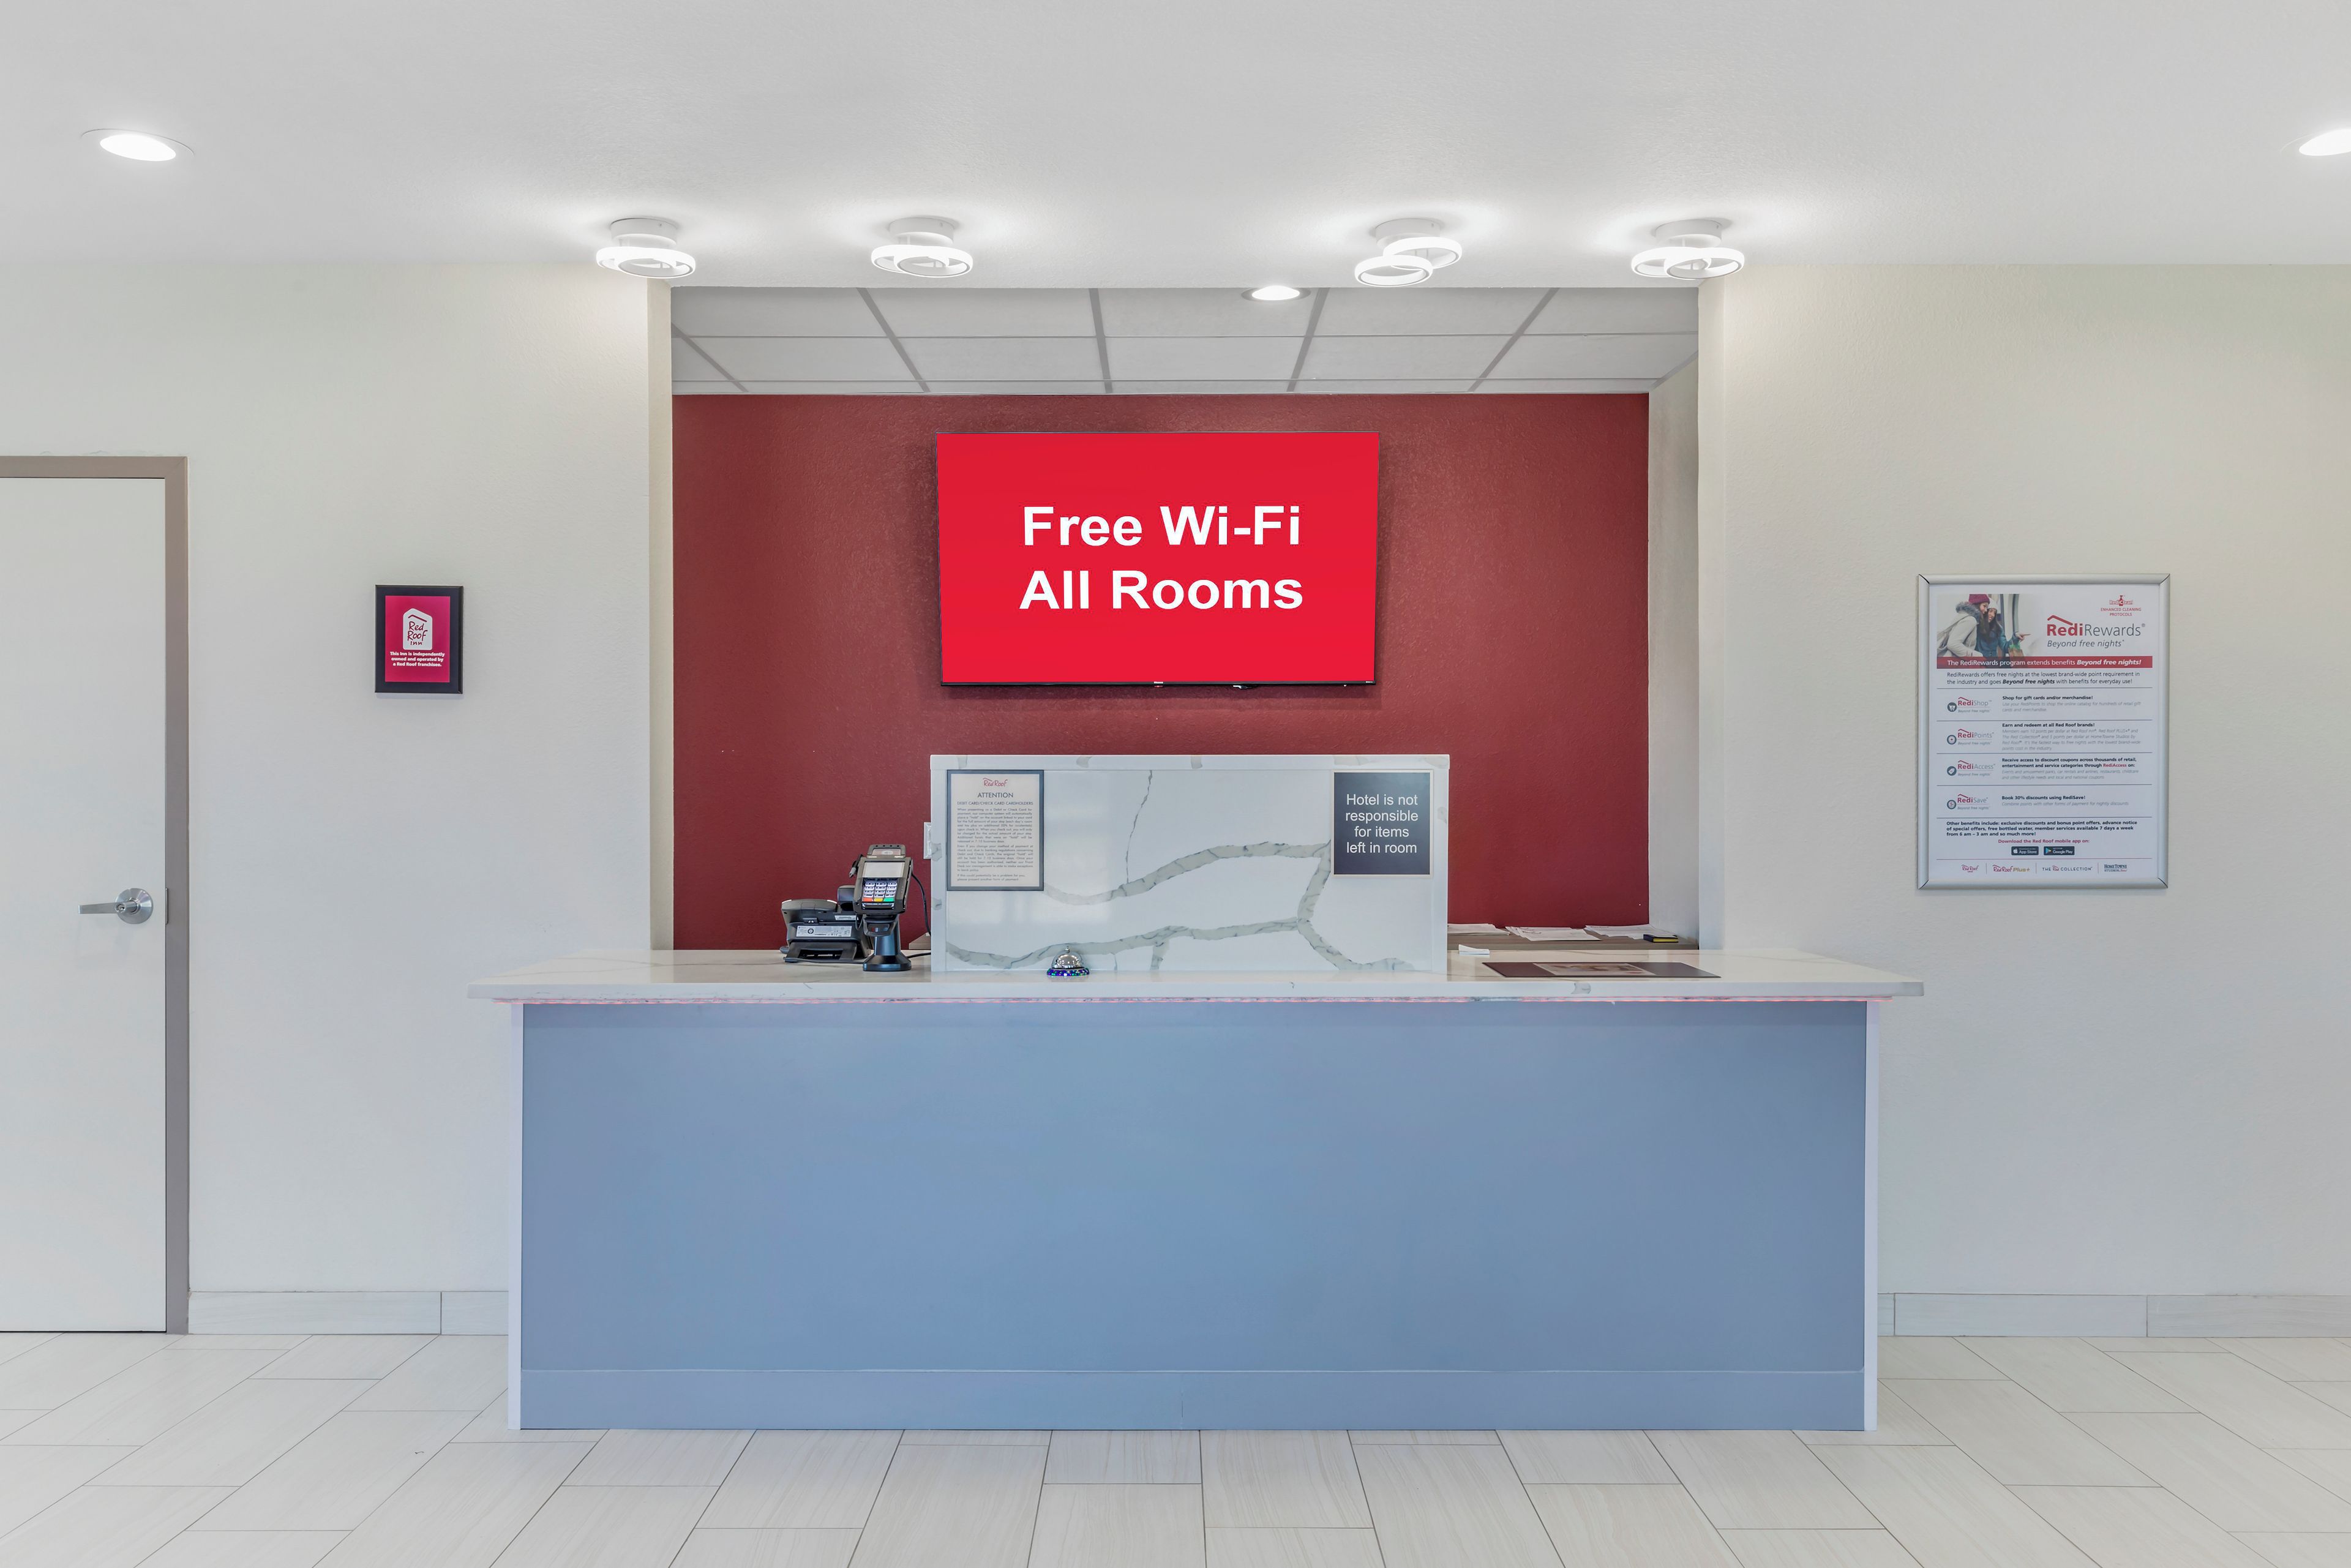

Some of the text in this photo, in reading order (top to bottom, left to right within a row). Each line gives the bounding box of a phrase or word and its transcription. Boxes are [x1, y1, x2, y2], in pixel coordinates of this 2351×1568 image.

[1023, 506, 1300, 546] Free Wi-Fi
[1019, 570, 1303, 609] All Rooms
[409, 621, 424, 631] Red
[407, 630, 428, 641] Roof
[2047, 640, 2077, 648] Beyond
[2098, 640, 2122, 648] nights
[1347, 793, 1418, 805] Hotel is not
[1346, 810, 1419, 824] responsible
[1354, 825, 1409, 838] for items
[1347, 842, 1417, 853] left in room
